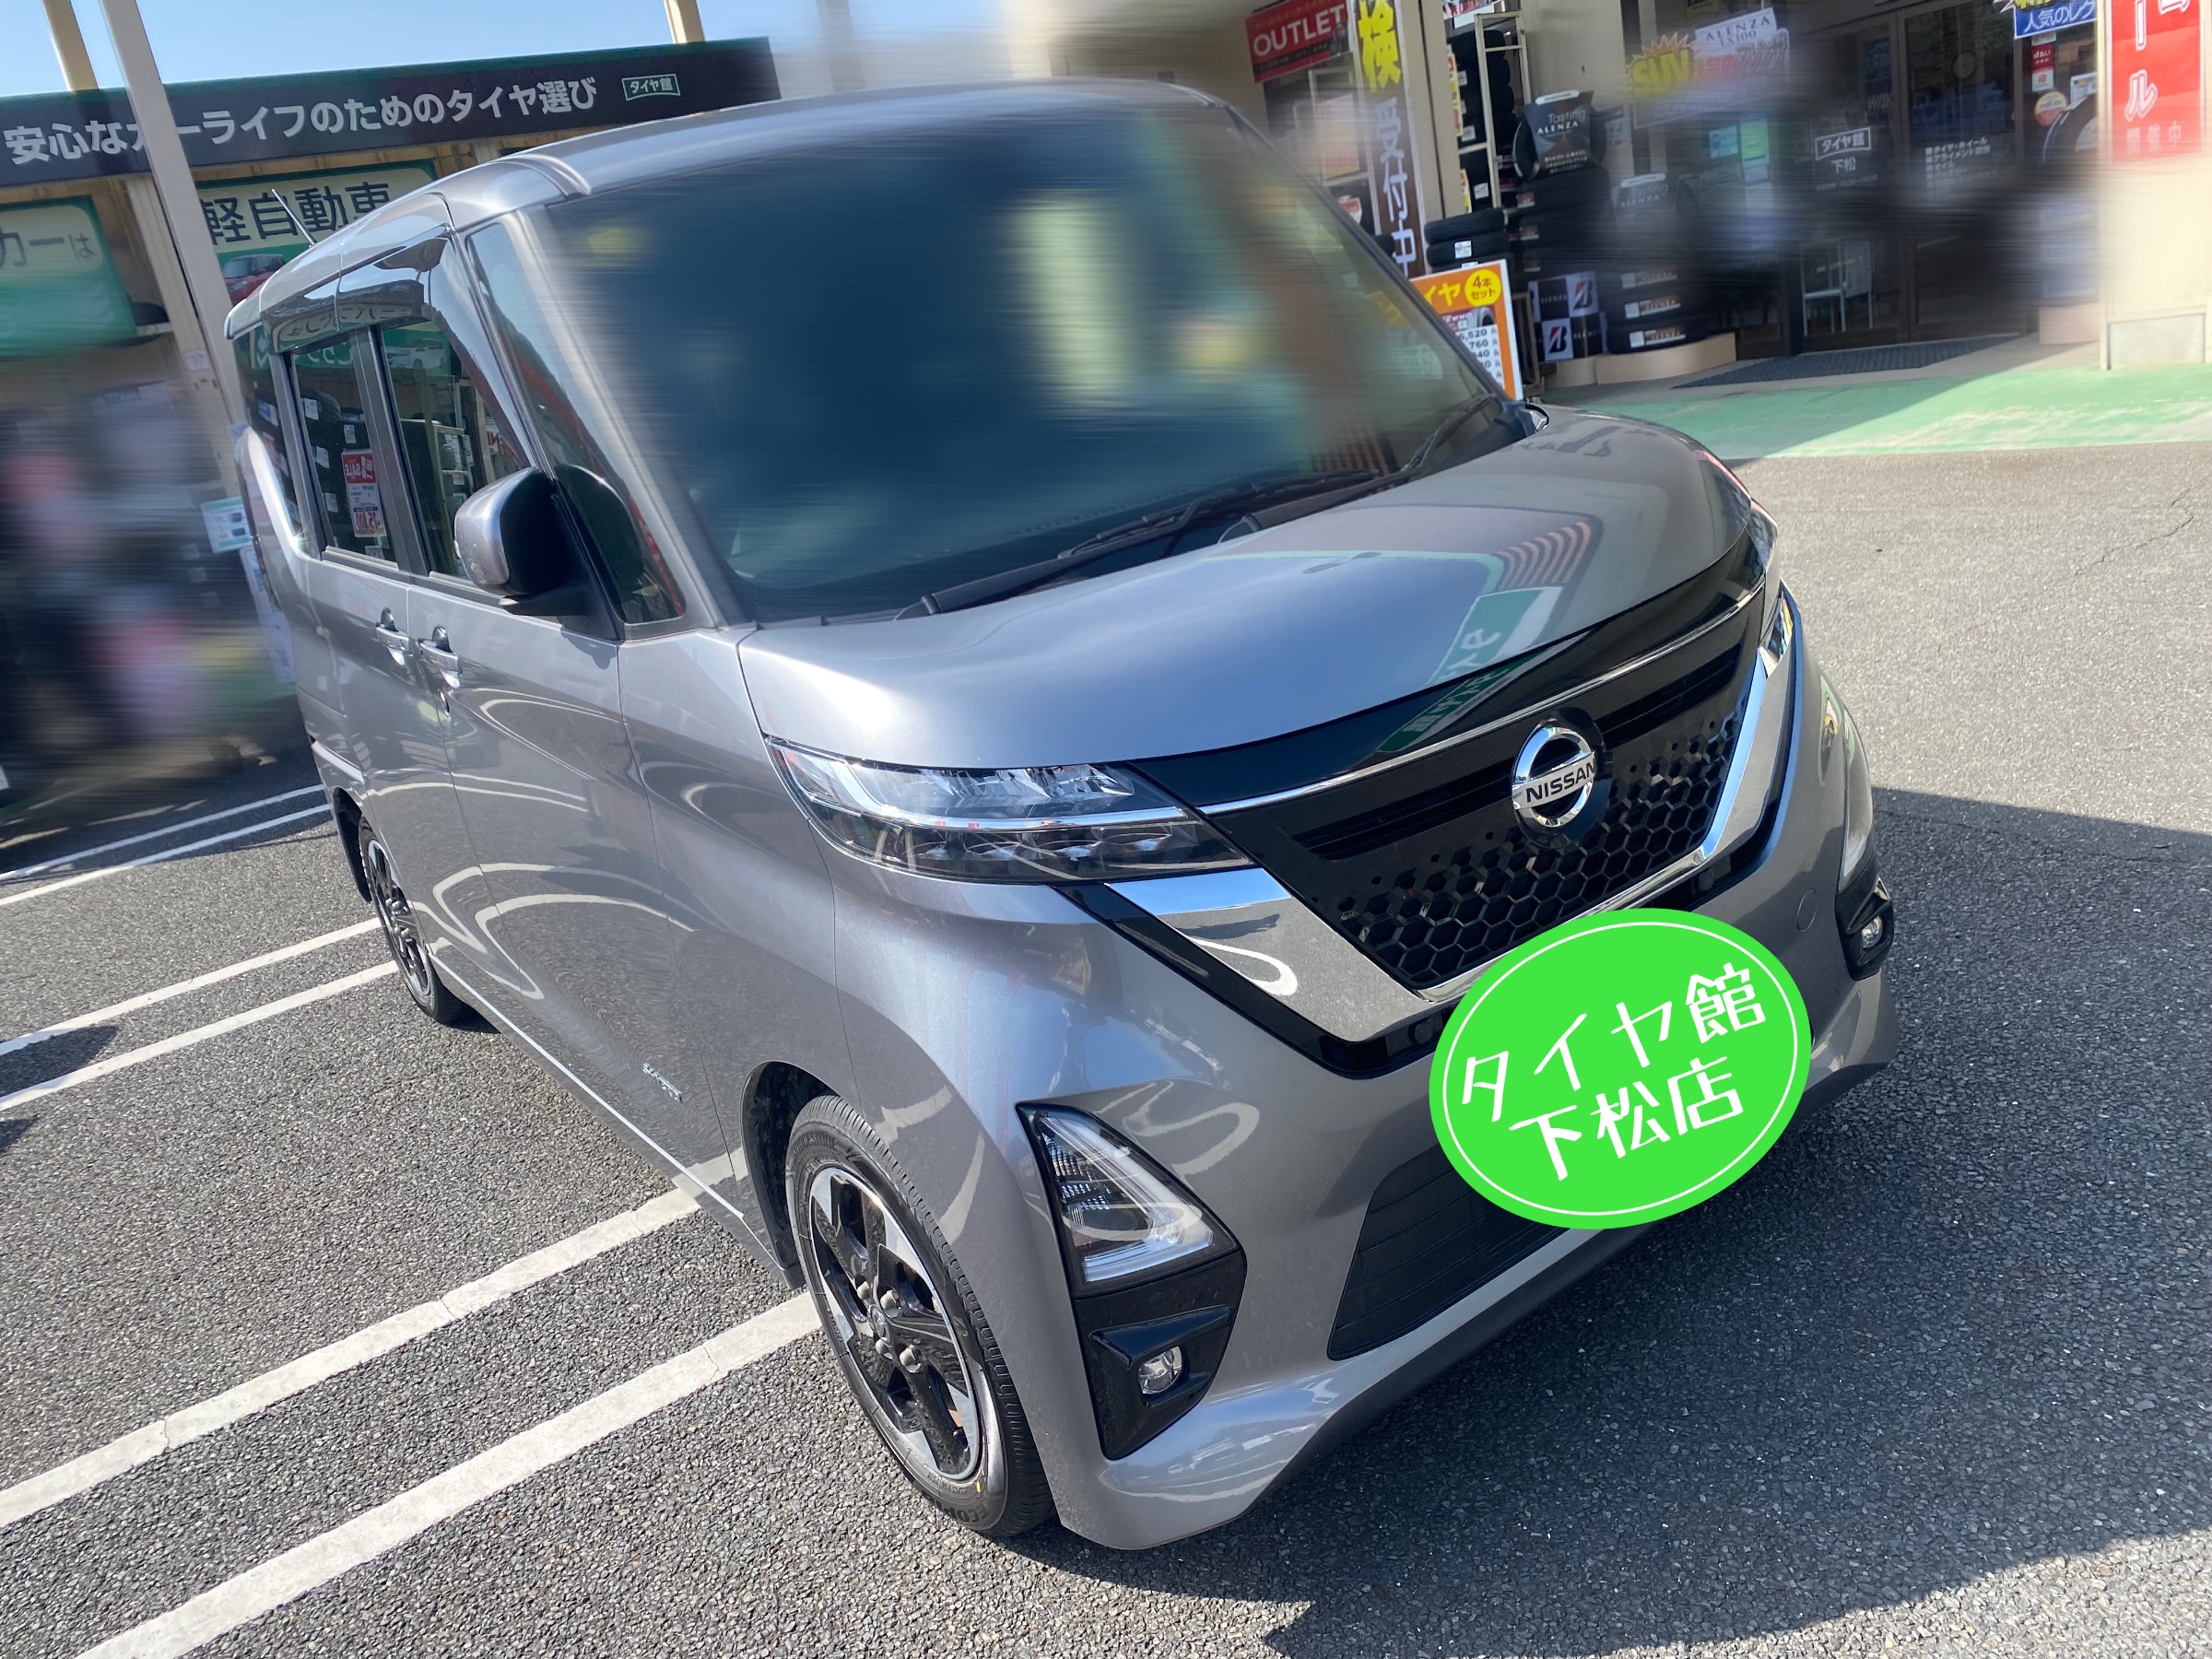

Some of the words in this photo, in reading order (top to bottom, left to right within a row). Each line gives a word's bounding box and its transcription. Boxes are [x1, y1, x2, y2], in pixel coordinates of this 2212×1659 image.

[1253, 4, 1345, 57] OUTLET
[1707, 16, 1771, 42] ALENZA
[1631, 48, 1696, 90] SUV
[629, 77, 674, 95] タイヤ館
[1547, 109, 1586, 125] Tasting
[1537, 121, 1580, 135] ALENZA
[1821, 131, 1865, 154] タイヤ館
[1831, 156, 1857, 174] 下松
[1472, 276, 1491, 288] 4本
[1525, 758, 1596, 803] NISSAN
